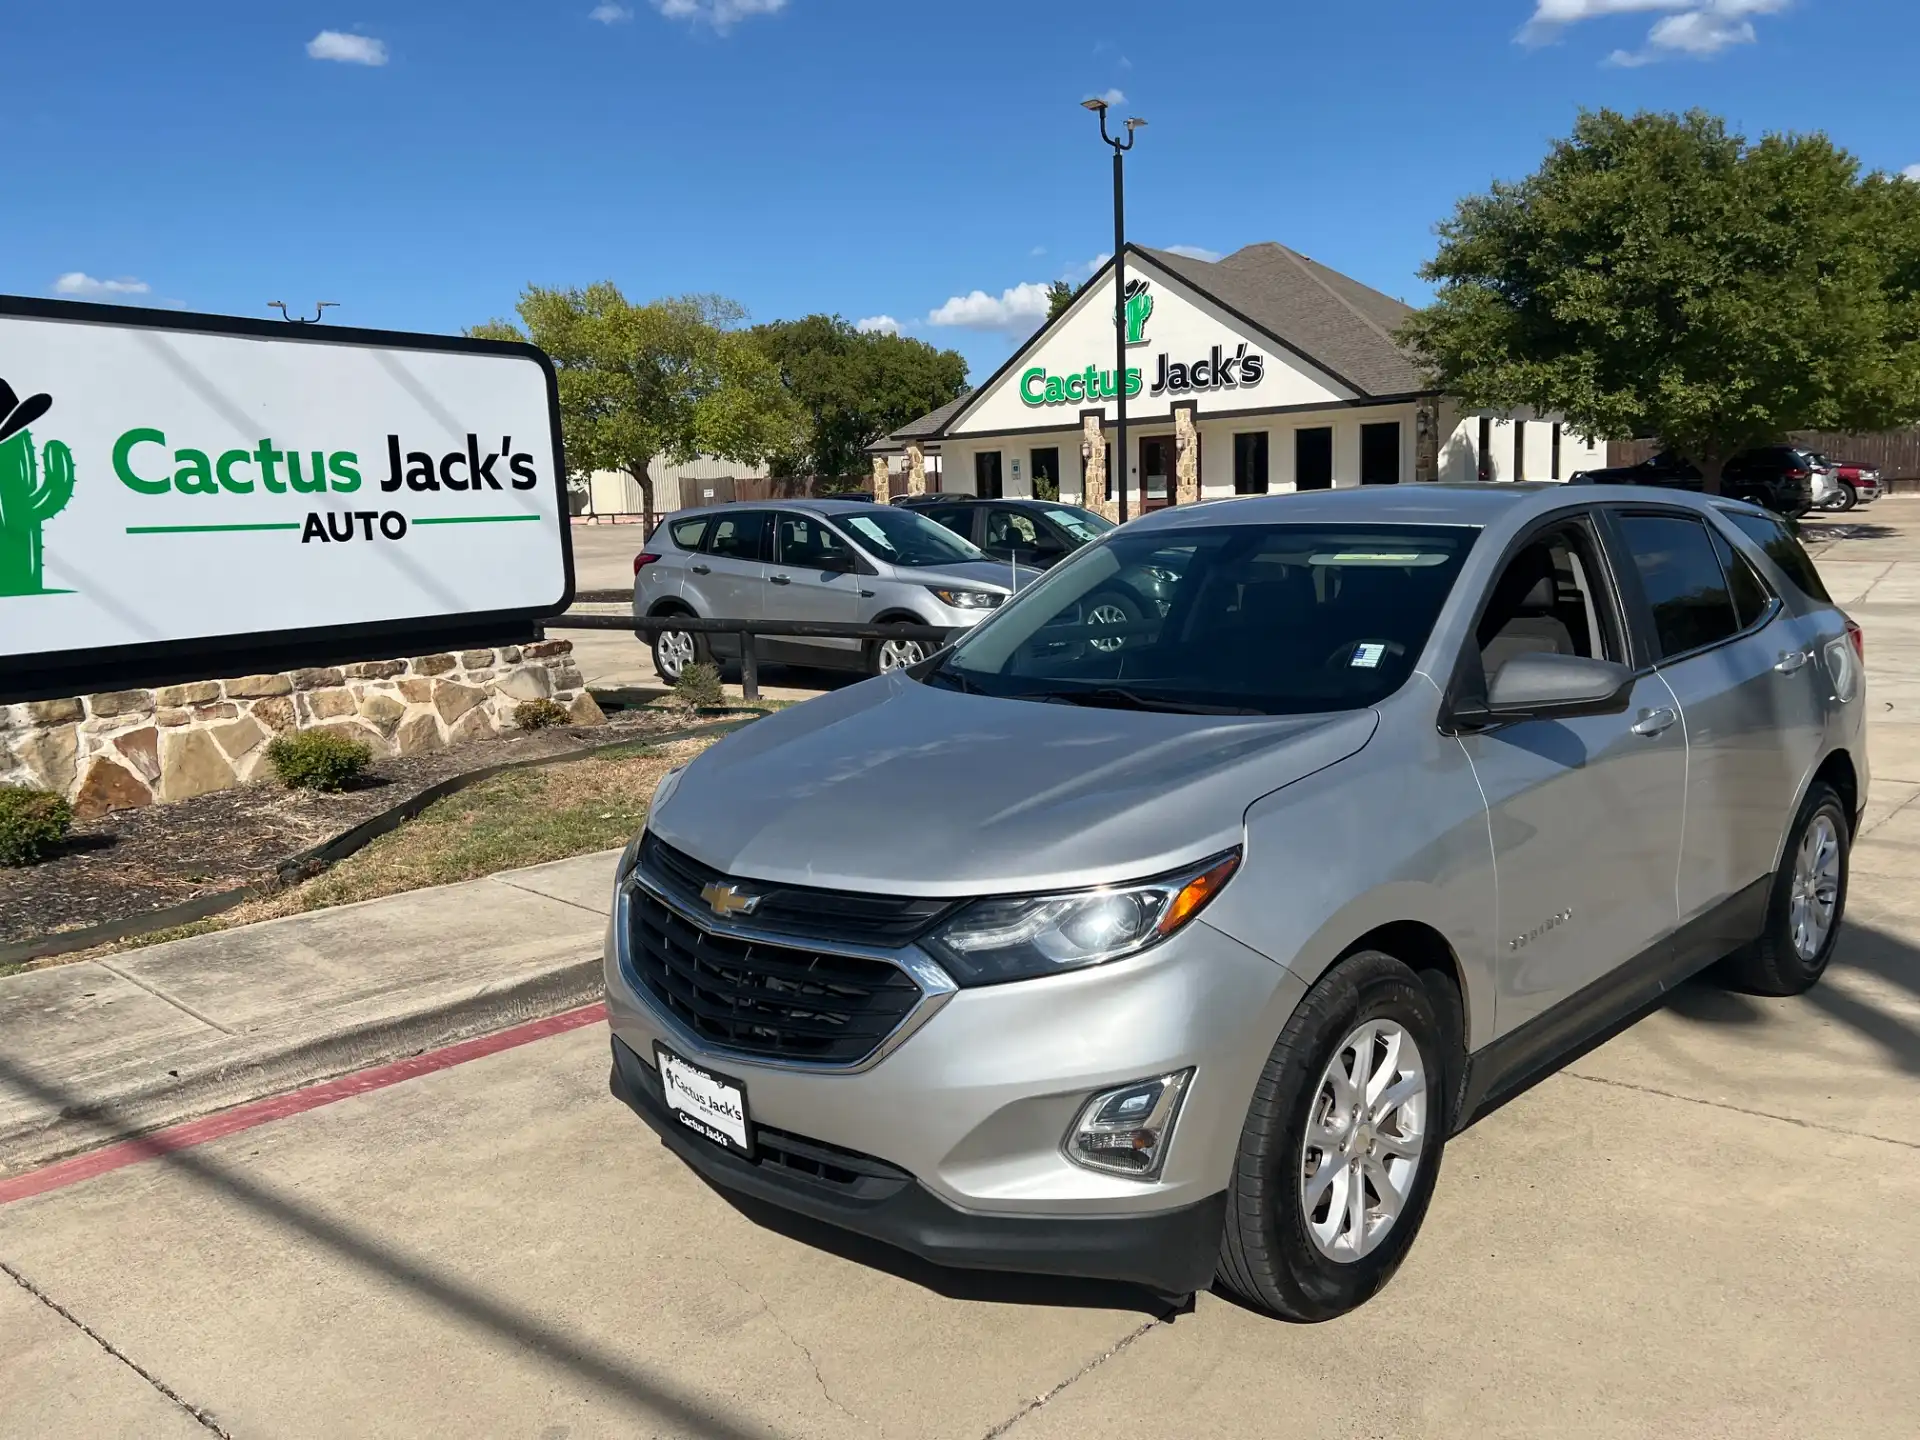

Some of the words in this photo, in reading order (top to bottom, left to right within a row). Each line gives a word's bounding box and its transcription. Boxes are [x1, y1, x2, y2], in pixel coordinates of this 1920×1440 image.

[1020, 364, 1142, 404] Cactus
[1151, 343, 1263, 393] Jack's
[112, 427, 362, 495] Cactus
[380, 433, 537, 493] Jack's
[301, 510, 407, 543] AUTO
[674, 1074, 706, 1105] Cactus
[708, 1095, 742, 1121] Jack's
[679, 1112, 705, 1134] Cactus
[706, 1127, 728, 1147] Jack's
